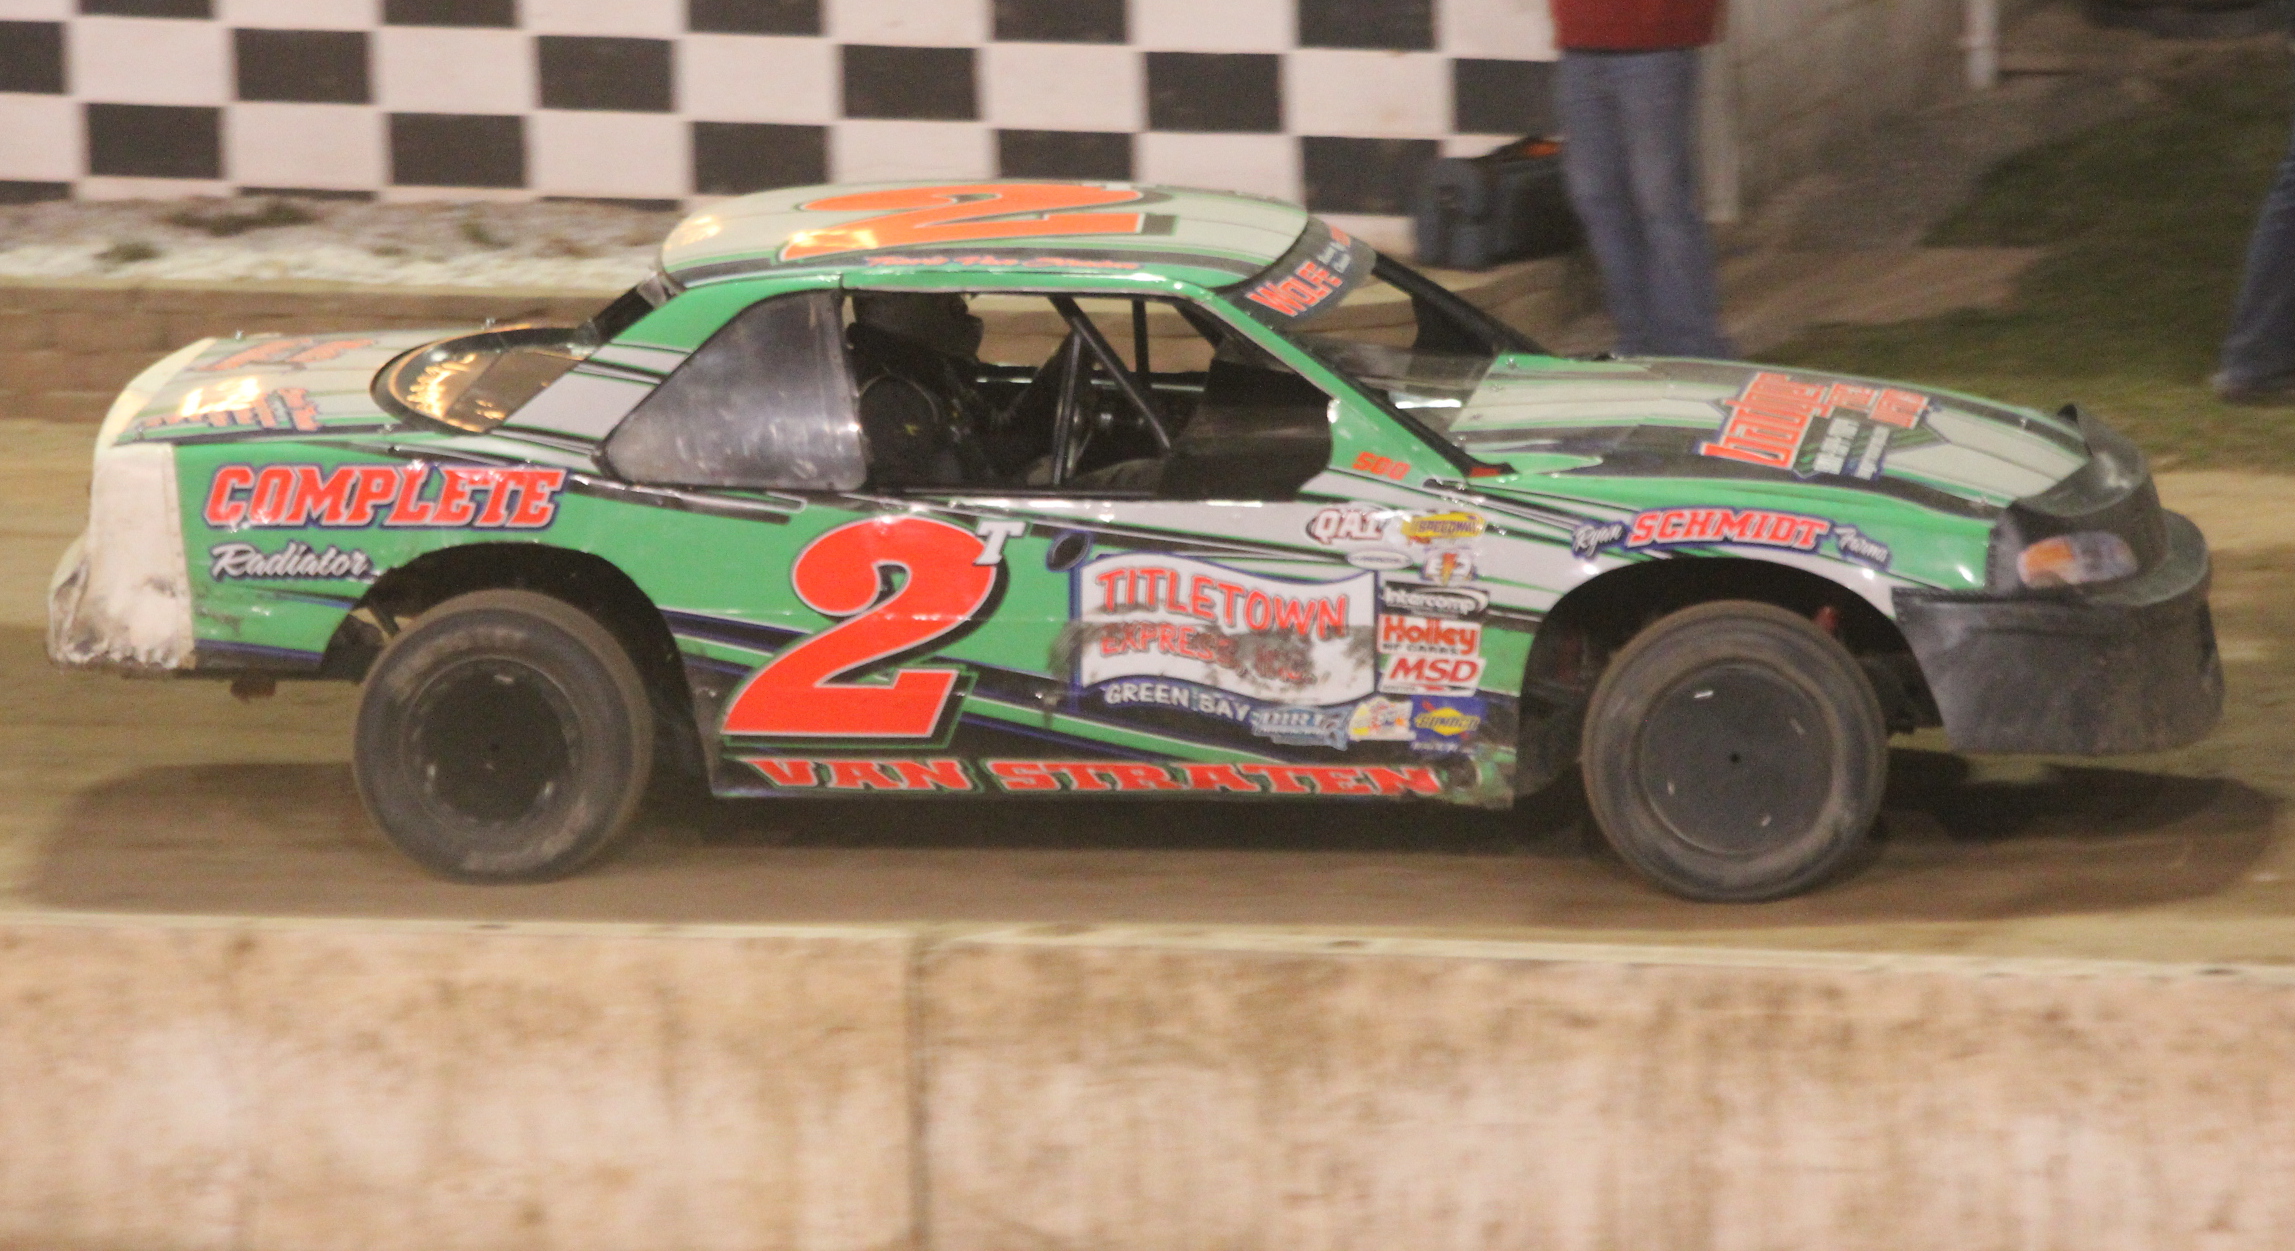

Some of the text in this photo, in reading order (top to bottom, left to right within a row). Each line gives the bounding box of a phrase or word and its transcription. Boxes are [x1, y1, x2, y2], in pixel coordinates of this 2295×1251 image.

[778, 183, 1142, 261] 2
[1244, 259, 1344, 318] WOLFE
[204, 465, 568, 529] COMPLETE
[1573, 523, 1623, 556] Ryan
[1625, 508, 1831, 550] SCHMIDT
[210, 541, 370, 579] Radiator
[1095, 564, 1350, 641] TITLETOWN
[1382, 586, 1477, 615] Intercomp
[720, 514, 1027, 738] 2 T
[1382, 615, 1478, 656] Holley
[1389, 657, 1480, 682] MSD
[1104, 682, 1252, 724] GREEN BAY
[737, 757, 1443, 796] VAN STRATEN
